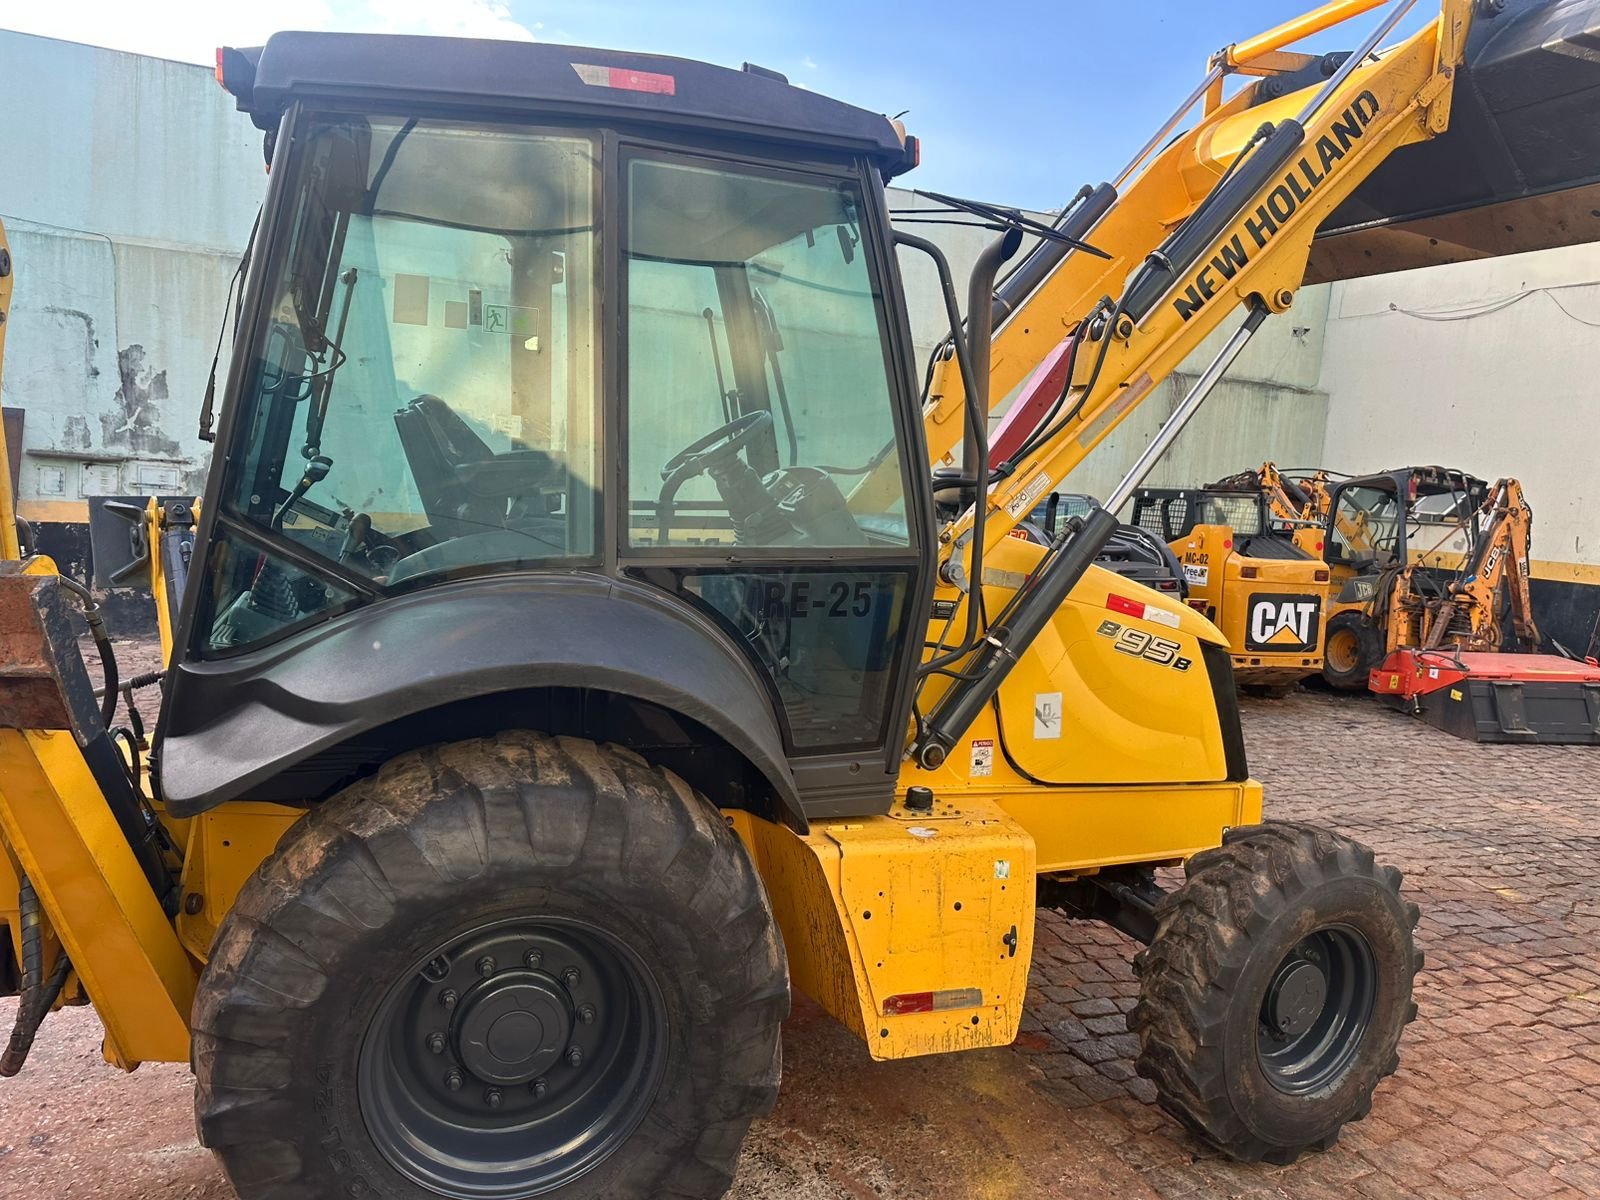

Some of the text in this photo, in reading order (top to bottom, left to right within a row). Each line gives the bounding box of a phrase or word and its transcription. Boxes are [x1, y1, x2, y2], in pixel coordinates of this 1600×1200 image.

[1172, 89, 1380, 322] NEW HOLLAND
[1185, 551, 1209, 565] MC-02
[1483, 547, 1499, 579] JCB
[764, 581, 872, 618] RE-25
[1251, 601, 1315, 644] CAT
